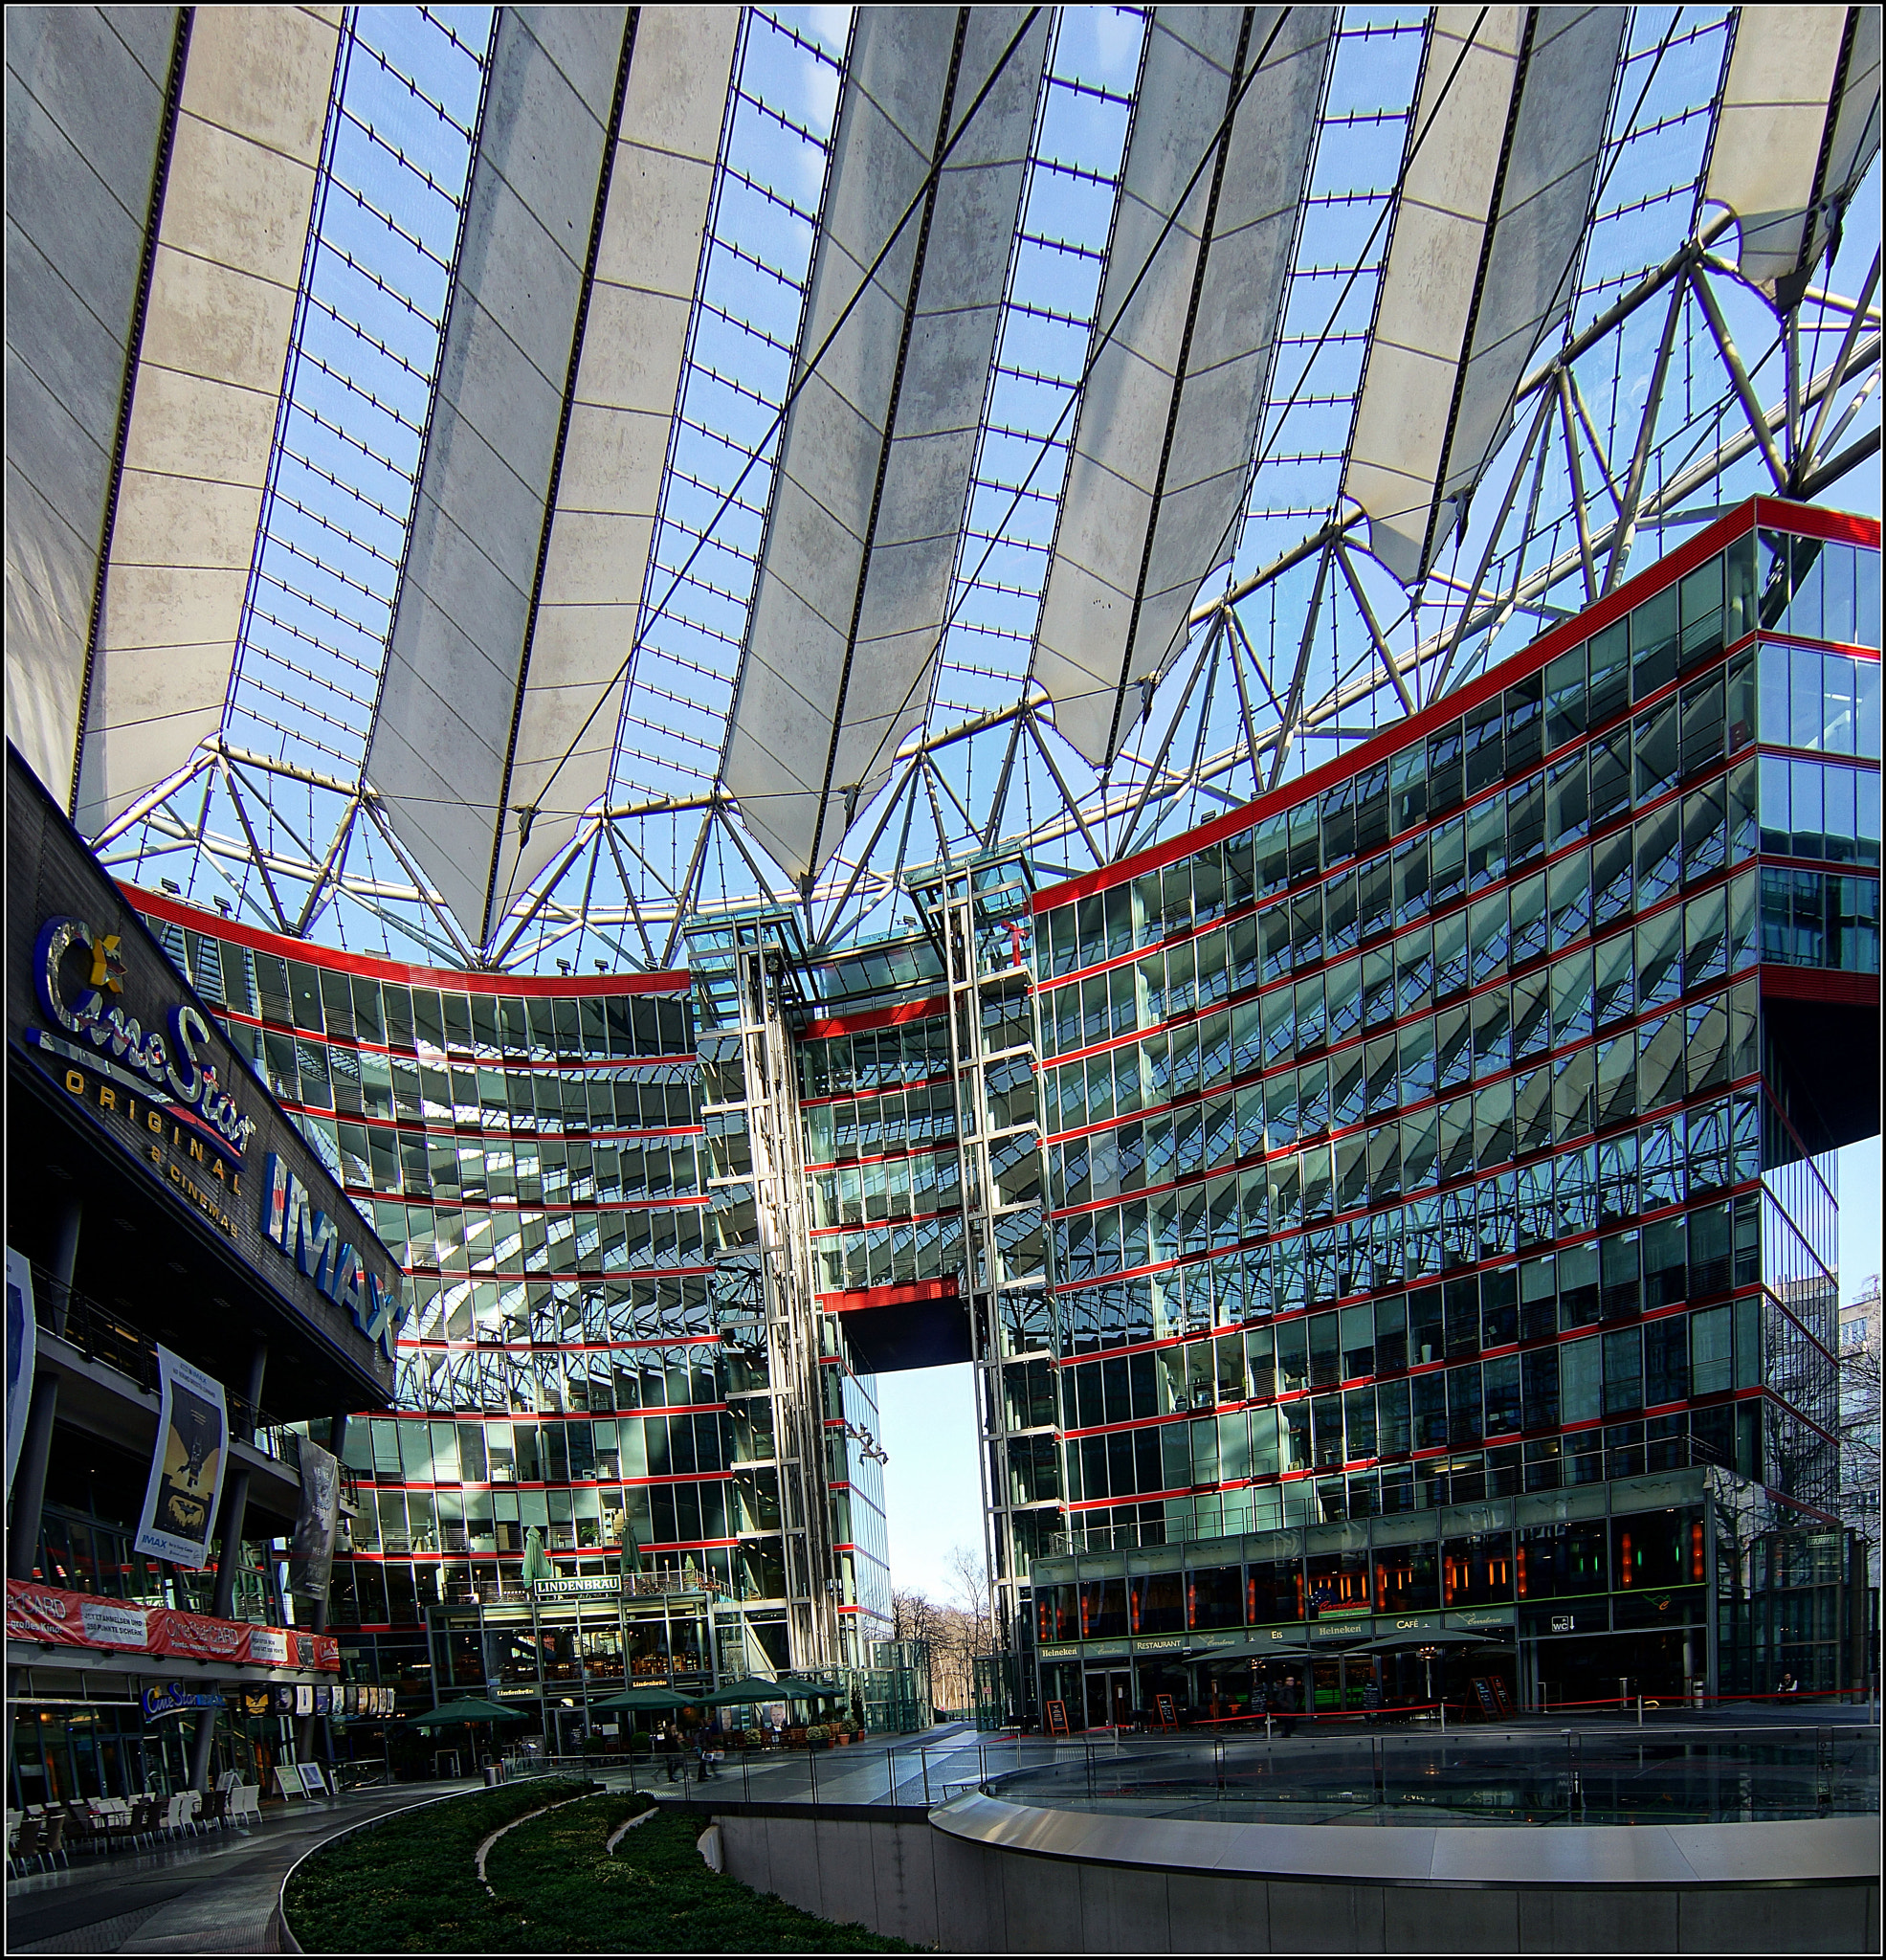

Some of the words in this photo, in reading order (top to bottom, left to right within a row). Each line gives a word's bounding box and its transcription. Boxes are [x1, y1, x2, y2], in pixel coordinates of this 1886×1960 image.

[34, 916, 256, 1154] CineStar
[66, 1069, 241, 1196] ORIGINAL
[170, 1165, 238, 1238] CINEMAS
[261, 1151, 402, 1364] IMAX
[142, 1534, 167, 1548] IMAX
[537, 1577, 618, 1593] LINDENBRÄU
[1319, 1624, 1362, 1636] Heineken
[1396, 1618, 1419, 1629] CAFÉ
[1553, 1622, 1568, 1631] WC
[1042, 1648, 1077, 1657] Heineken
[143, 1682, 197, 1714] CineStar
